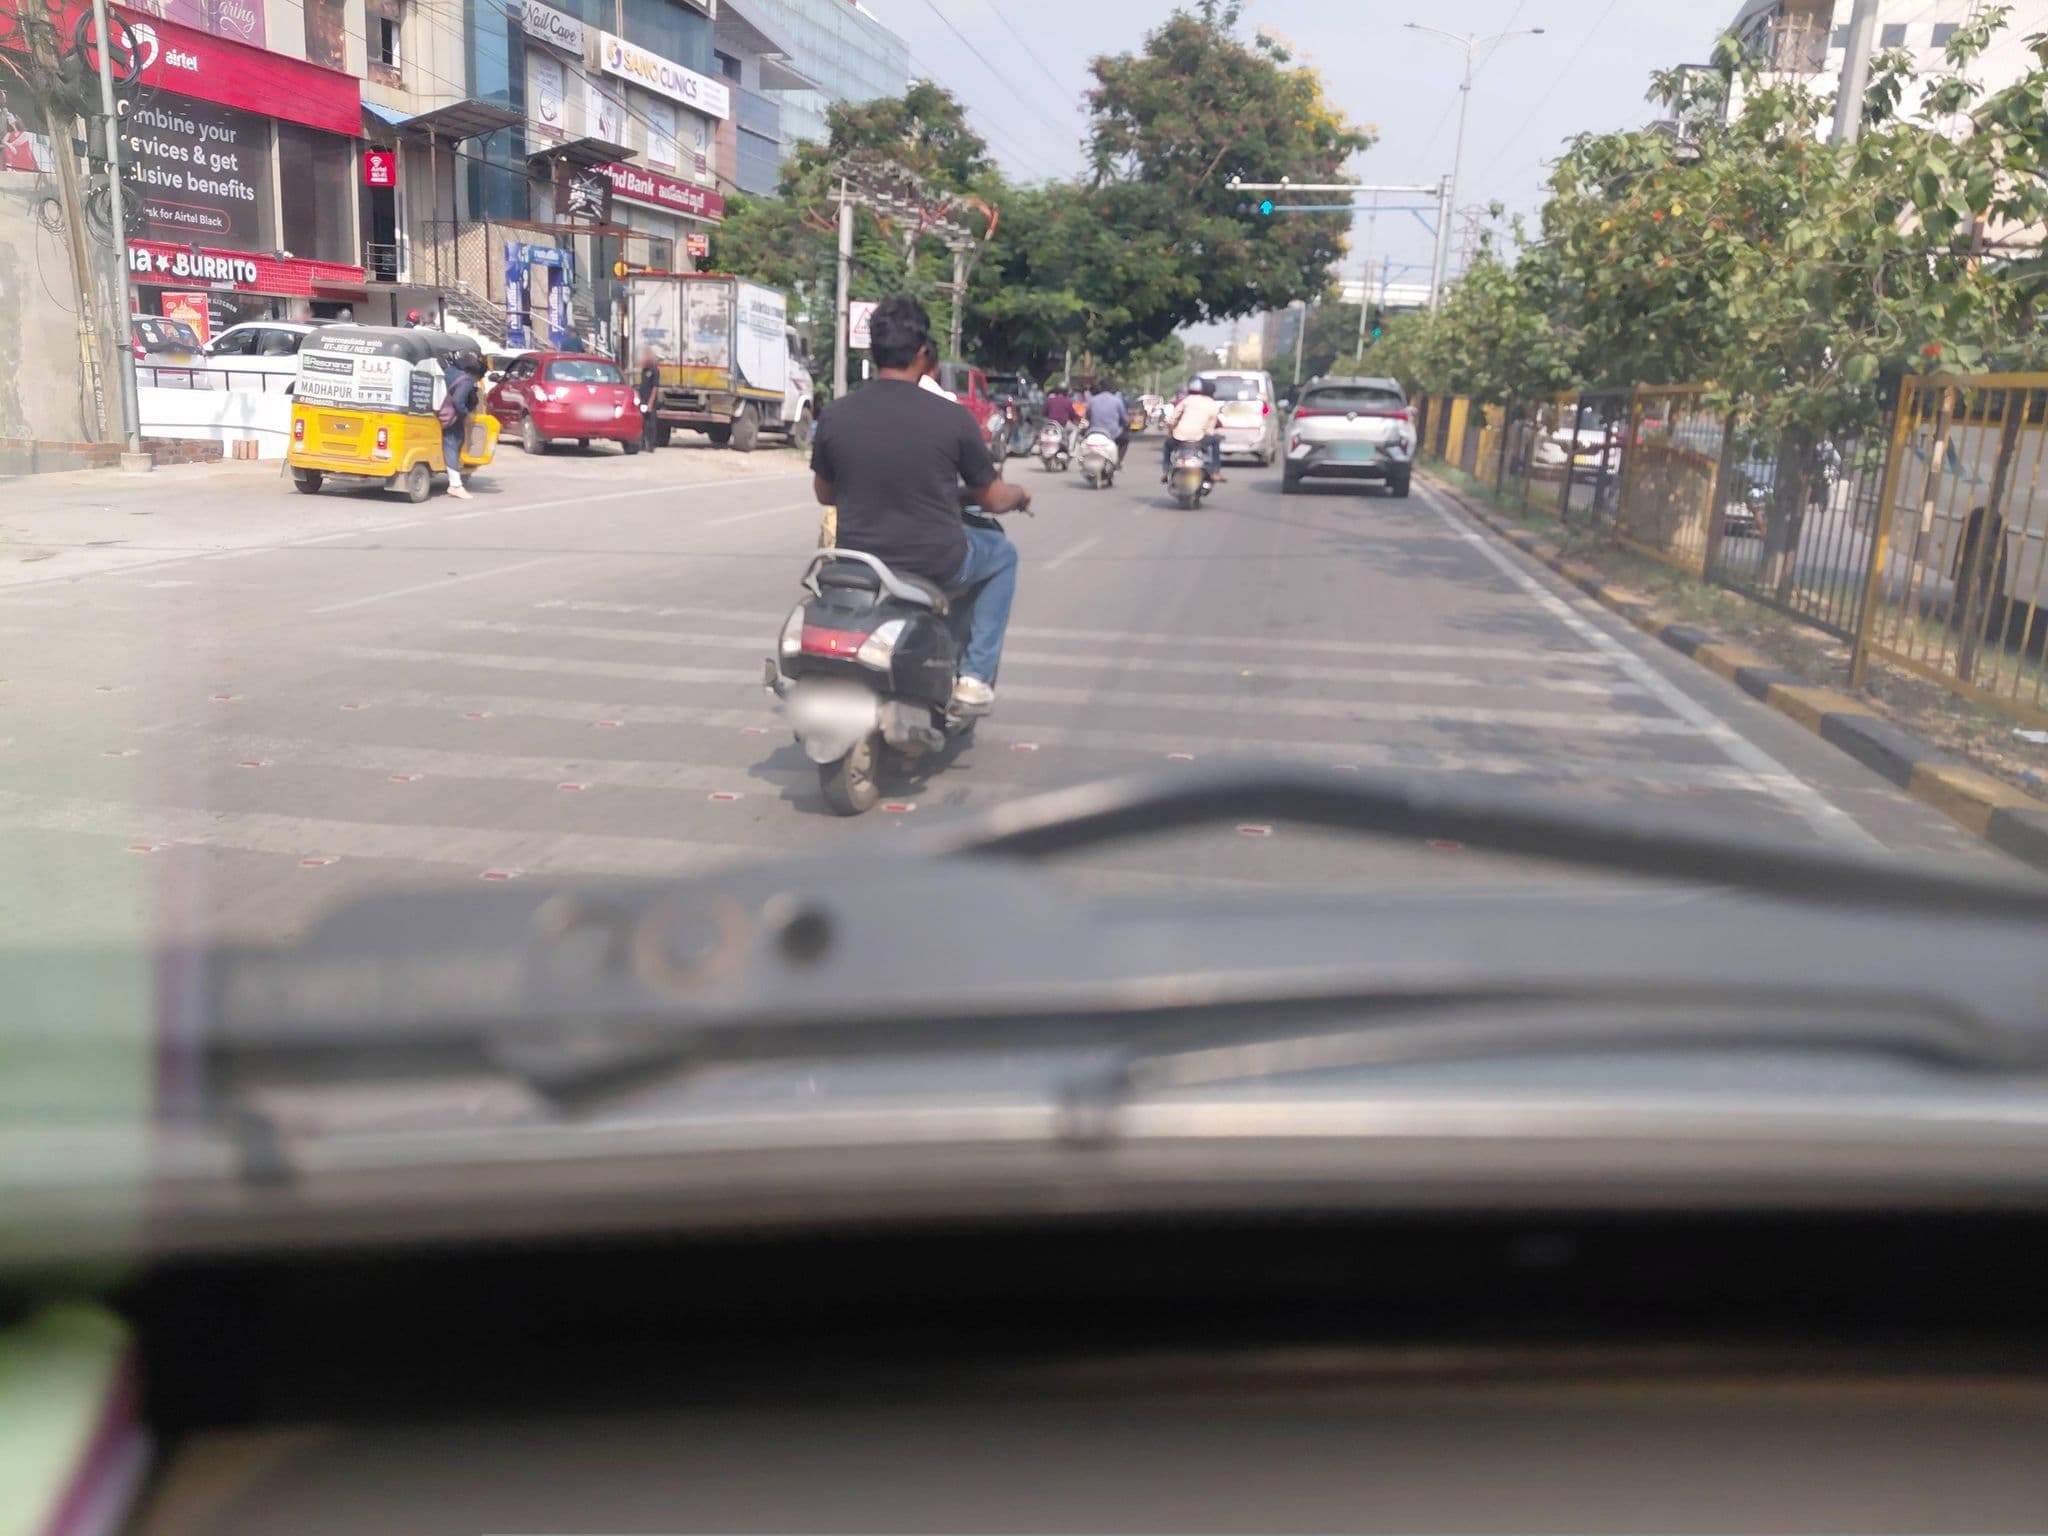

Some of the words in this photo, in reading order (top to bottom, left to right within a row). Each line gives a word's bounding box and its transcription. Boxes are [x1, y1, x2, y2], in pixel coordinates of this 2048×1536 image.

[522, 4, 550, 30] Nail
[165, 49, 199, 72] airtel
[624, 50, 659, 82] SANO
[660, 66, 698, 99] CLINICS
[199, 123, 237, 143] your
[193, 145, 207, 165] &
[210, 153, 239, 173] get
[187, 171, 255, 201] benefits
[627, 172, 655, 196] Bank
[159, 208, 173, 220] for
[174, 211, 198, 224] Airtel
[199, 214, 223, 228] Black
[172, 253, 257, 283] BURRITO
[301, 380, 353, 399] MADHAPUR
